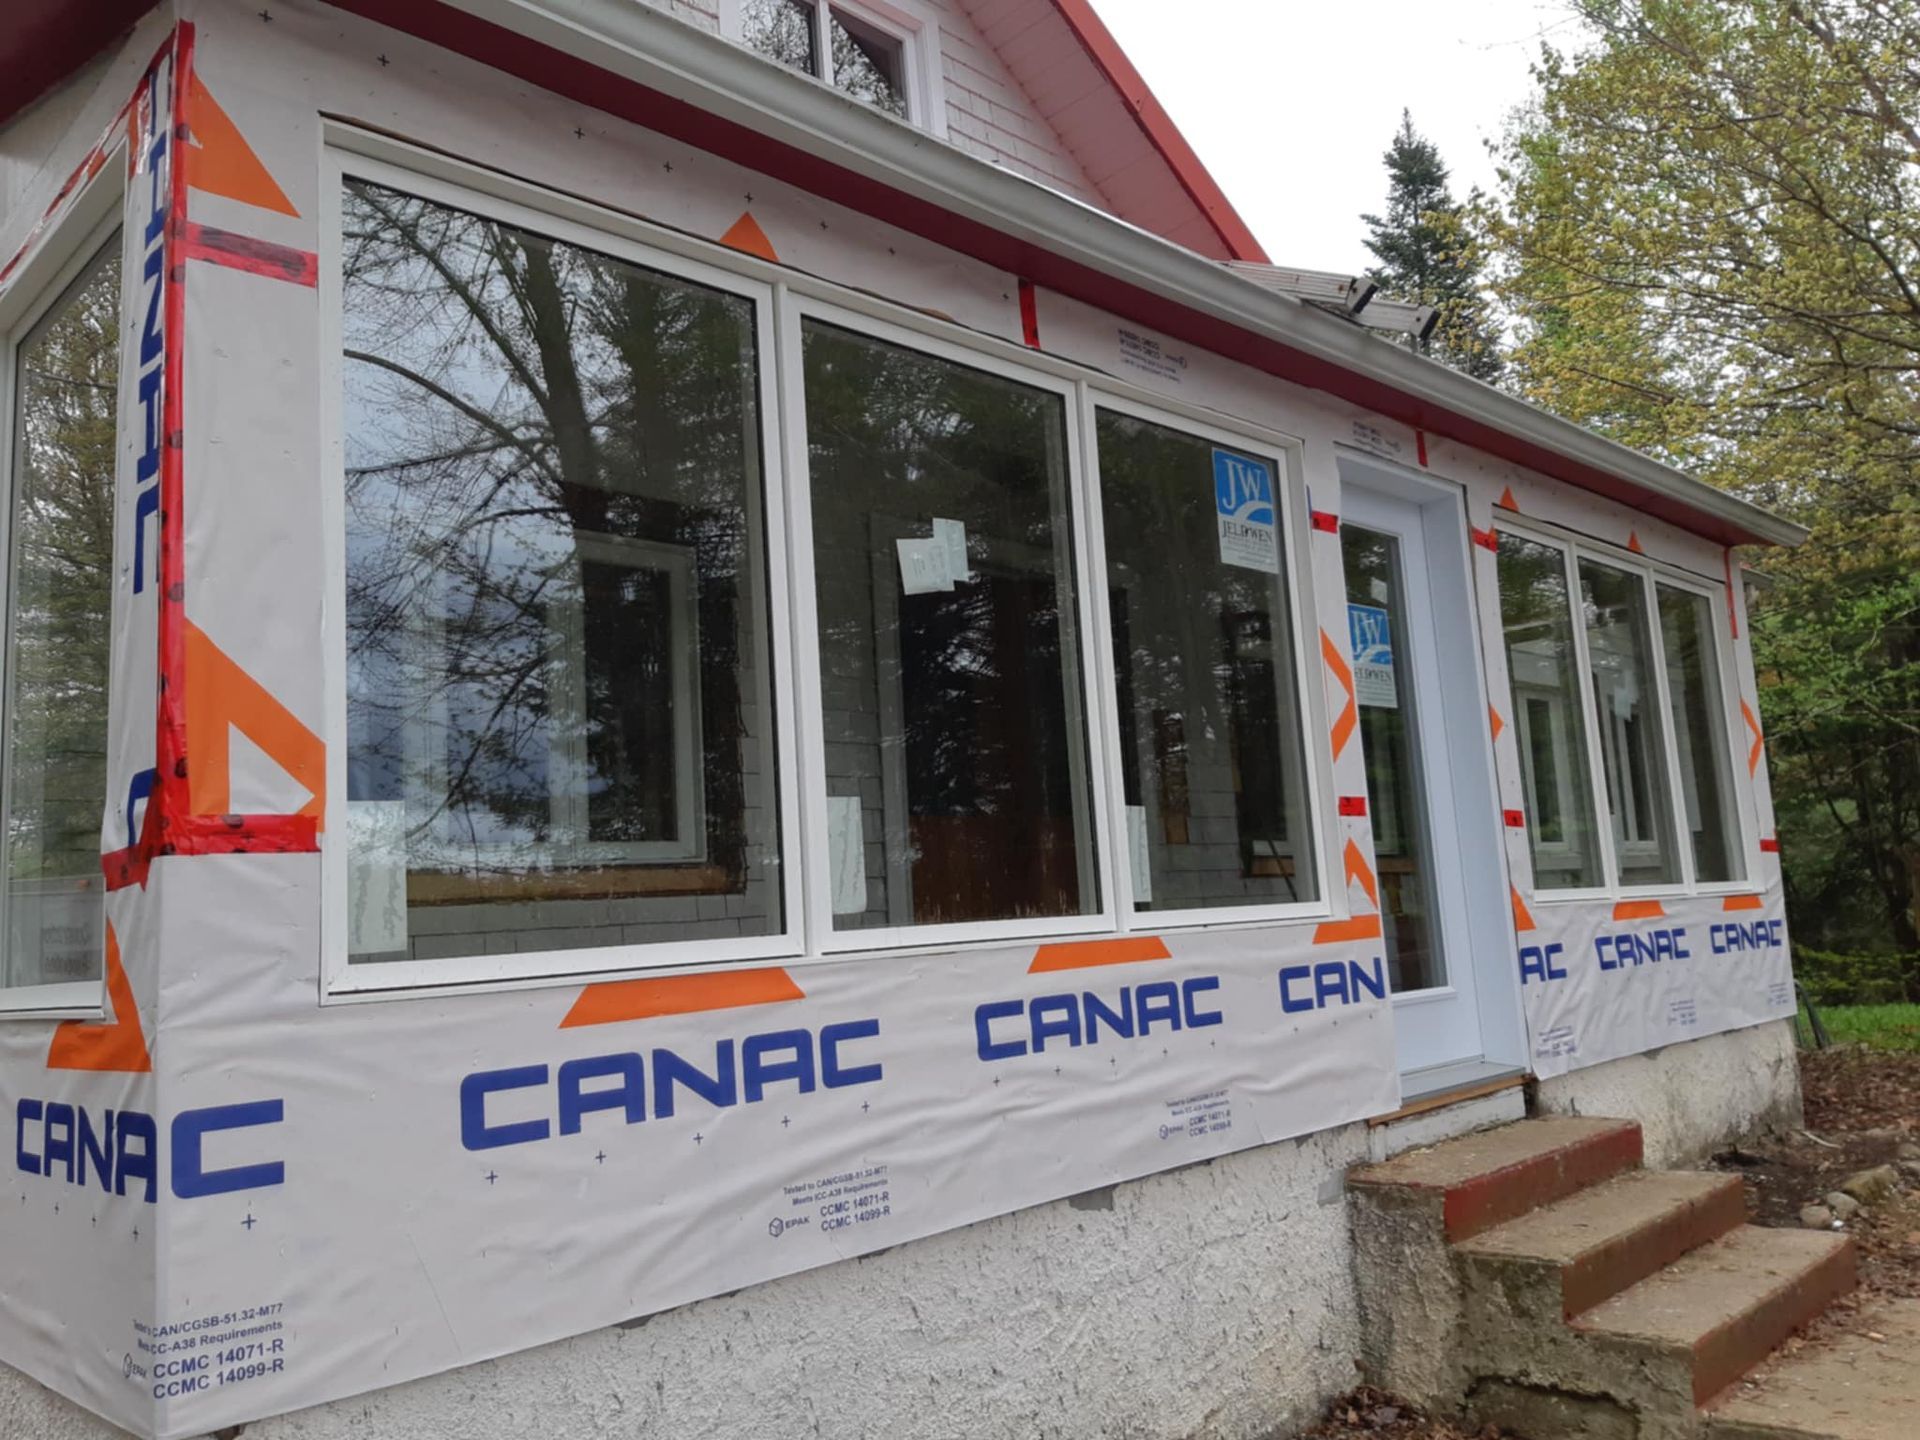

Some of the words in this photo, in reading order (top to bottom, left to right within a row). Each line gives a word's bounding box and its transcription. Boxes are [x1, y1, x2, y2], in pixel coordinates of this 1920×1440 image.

[1222, 458, 1262, 509] JW
[1595, 928, 1689, 970] CANAC
[1710, 920, 1781, 954] CANAC
[1279, 959, 1385, 1013] CAN
[975, 976, 1222, 1061] CANAC
[461, 1020, 882, 1150] CANAC
[17, 1099, 284, 1203] CANAC
[785, 1216, 810, 1229] EPAK
[820, 1201, 850, 1217] CCMC
[853, 1191, 889, 1209] 14071-R
[821, 1215, 852, 1232] CCMC
[854, 1206, 891, 1224] 14099-R
[152, 1303, 284, 1338] CAN/CGSB-51.32-M77
[199, 1320, 283, 1347] Requirements
[153, 1355, 209, 1379] CCMC
[216, 1338, 284, 1366] 14071-R
[153, 1375, 210, 1399] CCMC
[216, 1358, 284, 1386] 14099-R
